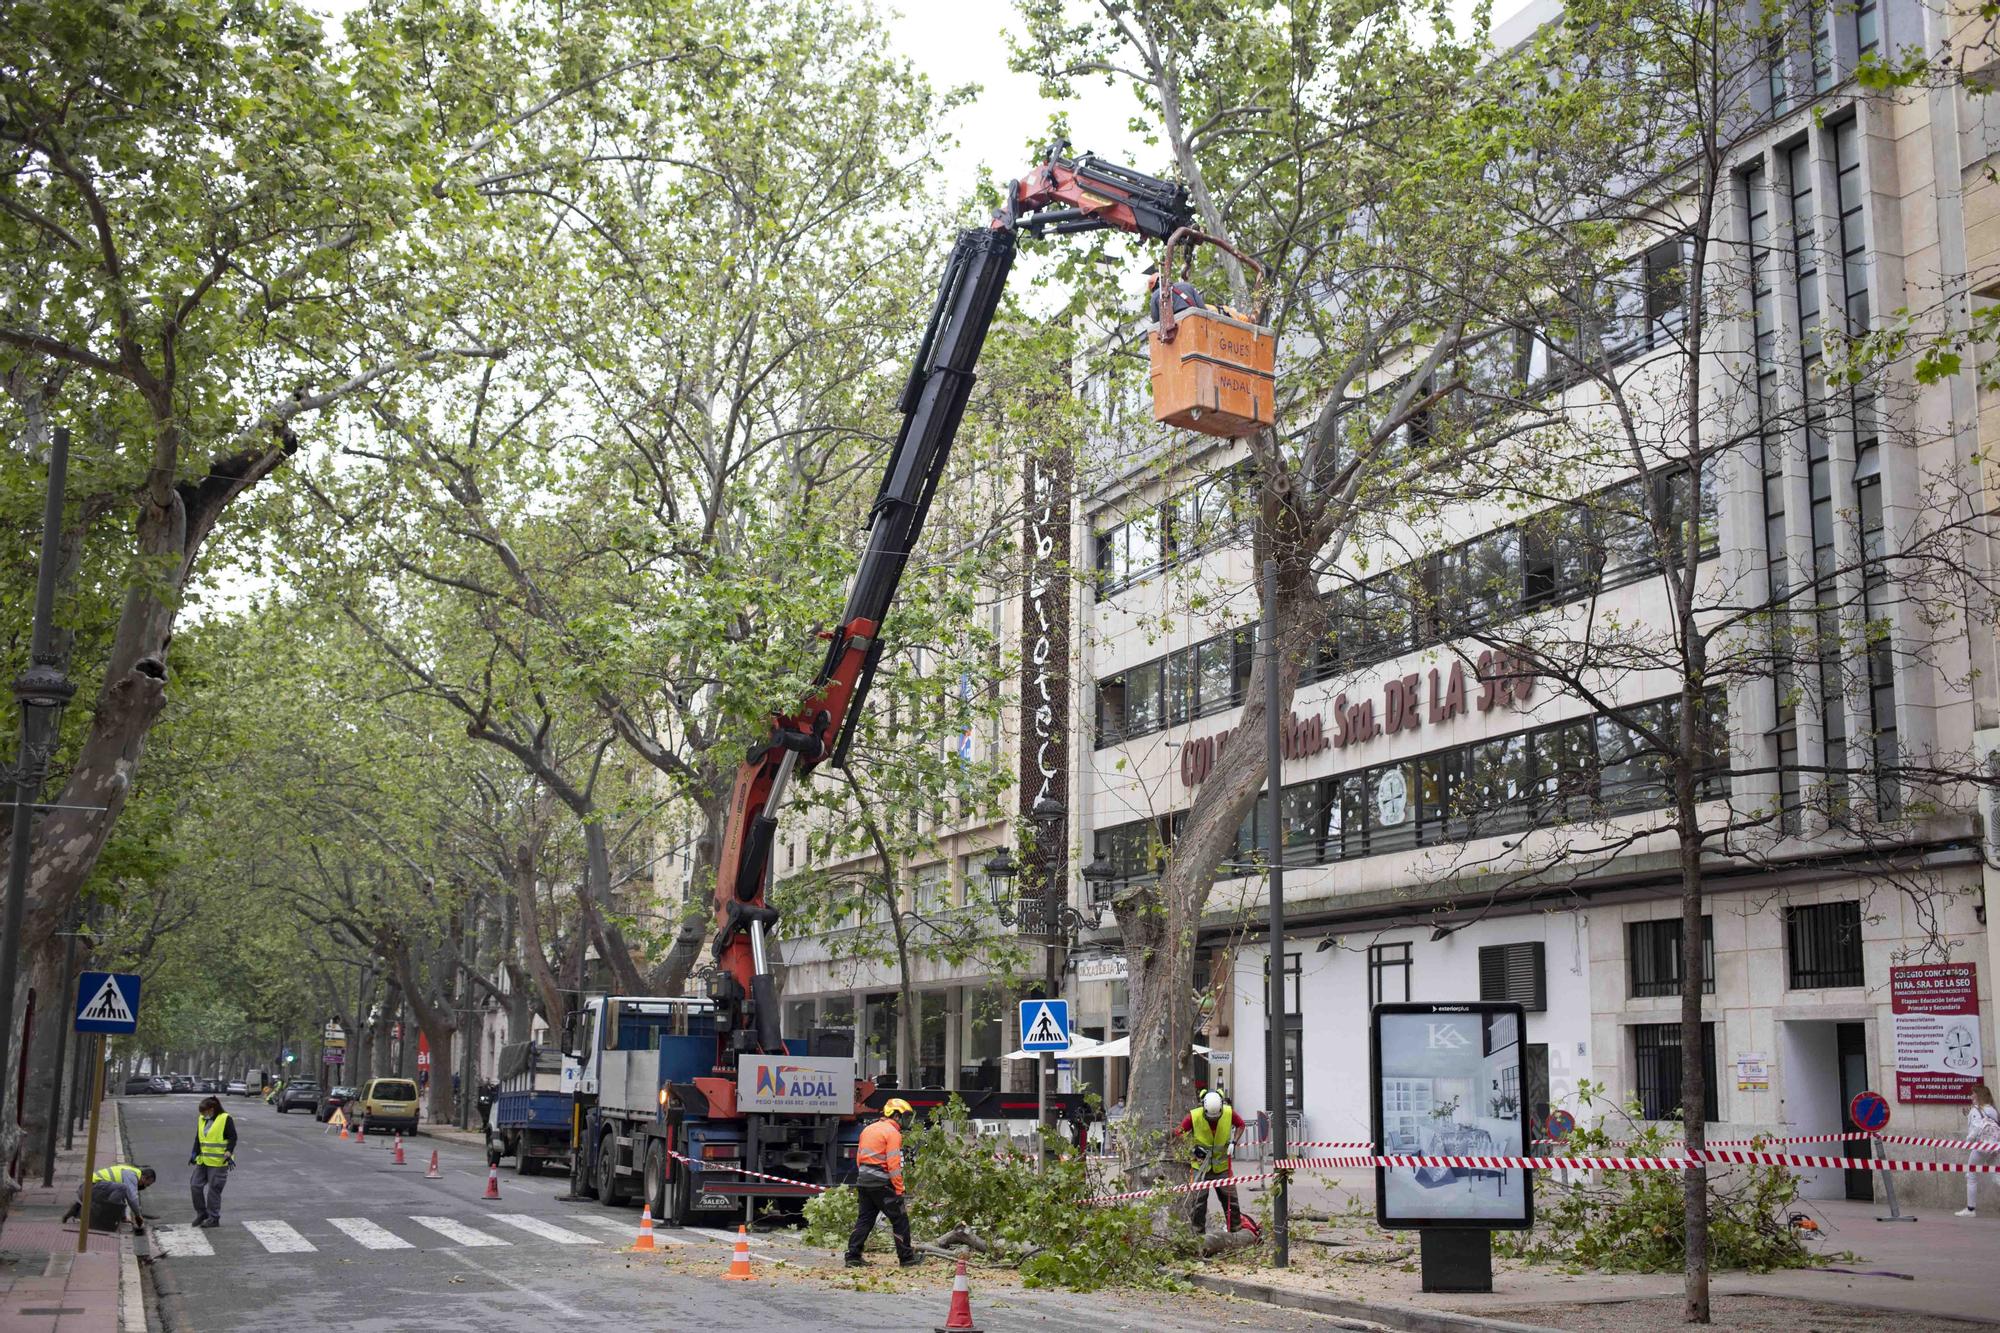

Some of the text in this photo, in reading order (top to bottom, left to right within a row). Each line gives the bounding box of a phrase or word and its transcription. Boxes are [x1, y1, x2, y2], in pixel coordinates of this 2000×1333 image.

[1219, 338, 1249, 357] GRUES
[1220, 376, 1251, 394] NADAL
[1334, 692, 1382, 748] Sra.
[1384, 672, 1420, 735] DE
[1428, 659, 1465, 724] LA
[1894, 981, 1915, 989] NTRA.
[1916, 980, 1932, 988] SRA.
[1946, 979, 1955, 987] LA
[1956, 978, 1971, 986] SEO
